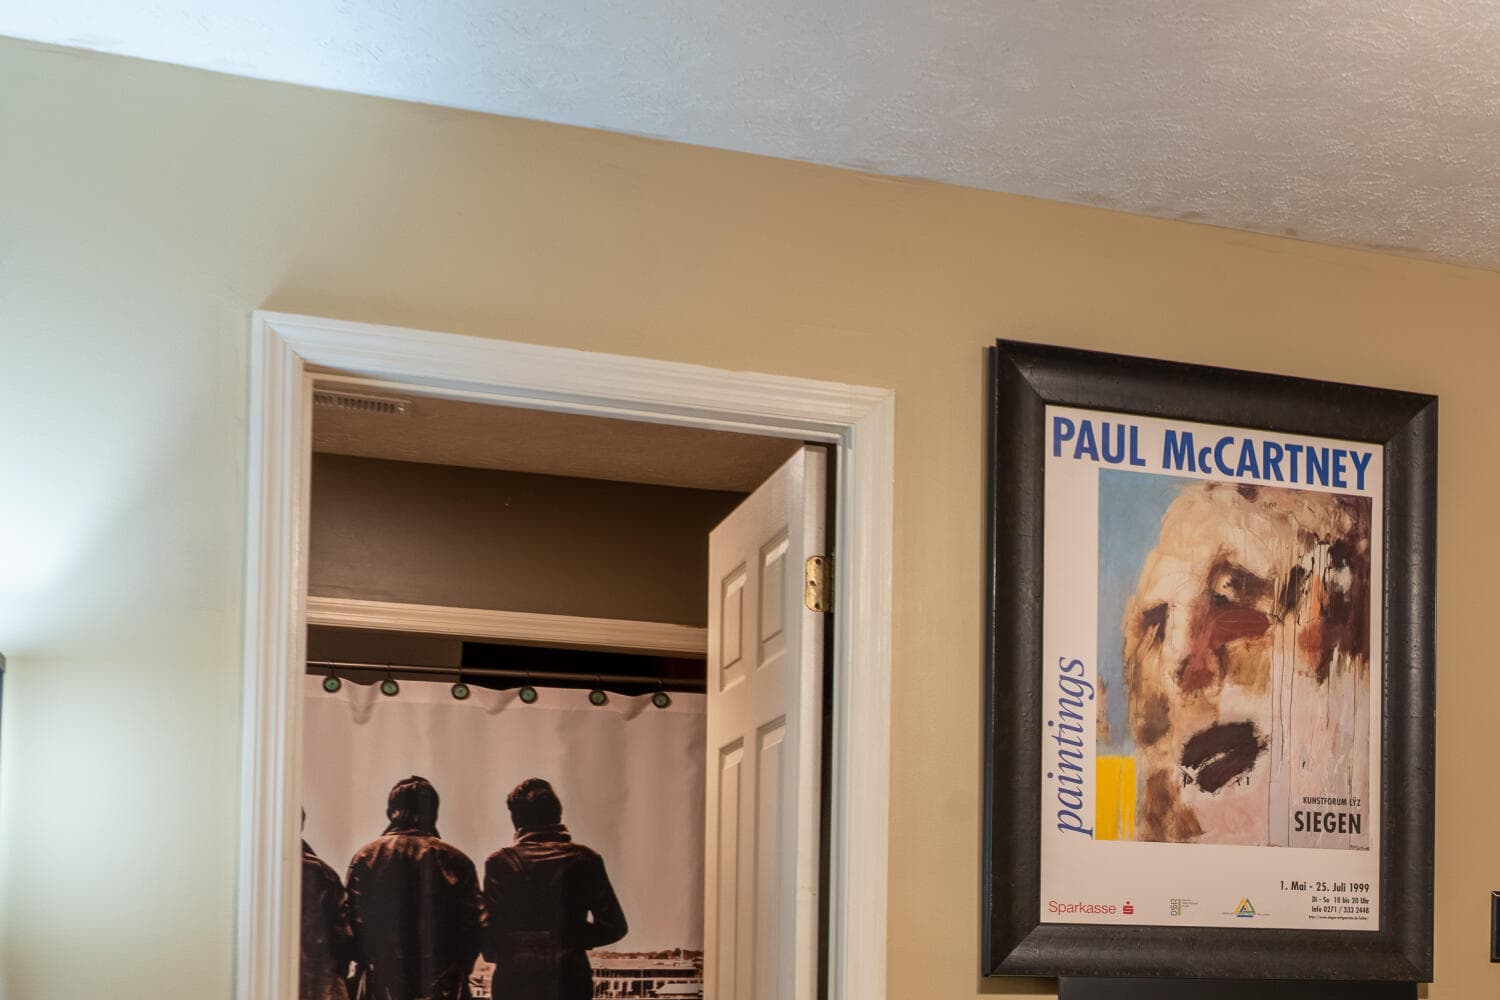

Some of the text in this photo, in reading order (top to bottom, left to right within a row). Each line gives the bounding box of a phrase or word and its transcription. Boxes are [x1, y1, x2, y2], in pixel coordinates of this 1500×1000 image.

[1052, 416, 1373, 490] PAUL McCARTNEY
[1047, 656, 1095, 840] paintings
[1302, 796, 1347, 806] KUNSTFORUM
[1294, 810, 1362, 835] SIEGEN
[1280, 880, 1288, 891] 1.
[1291, 881, 1307, 891] Mai
[1315, 881, 1330, 892] 25.
[1332, 882, 1346, 892] Juli
[1349, 882, 1370, 893] 1999
[1342, 896, 1350, 904] bis
[1048, 900, 1117, 915] Sparkasse
[1311, 905, 1322, 913] Info
[1323, 905, 1337, 913] 0271
[1343, 906, 1354, 914] 333
